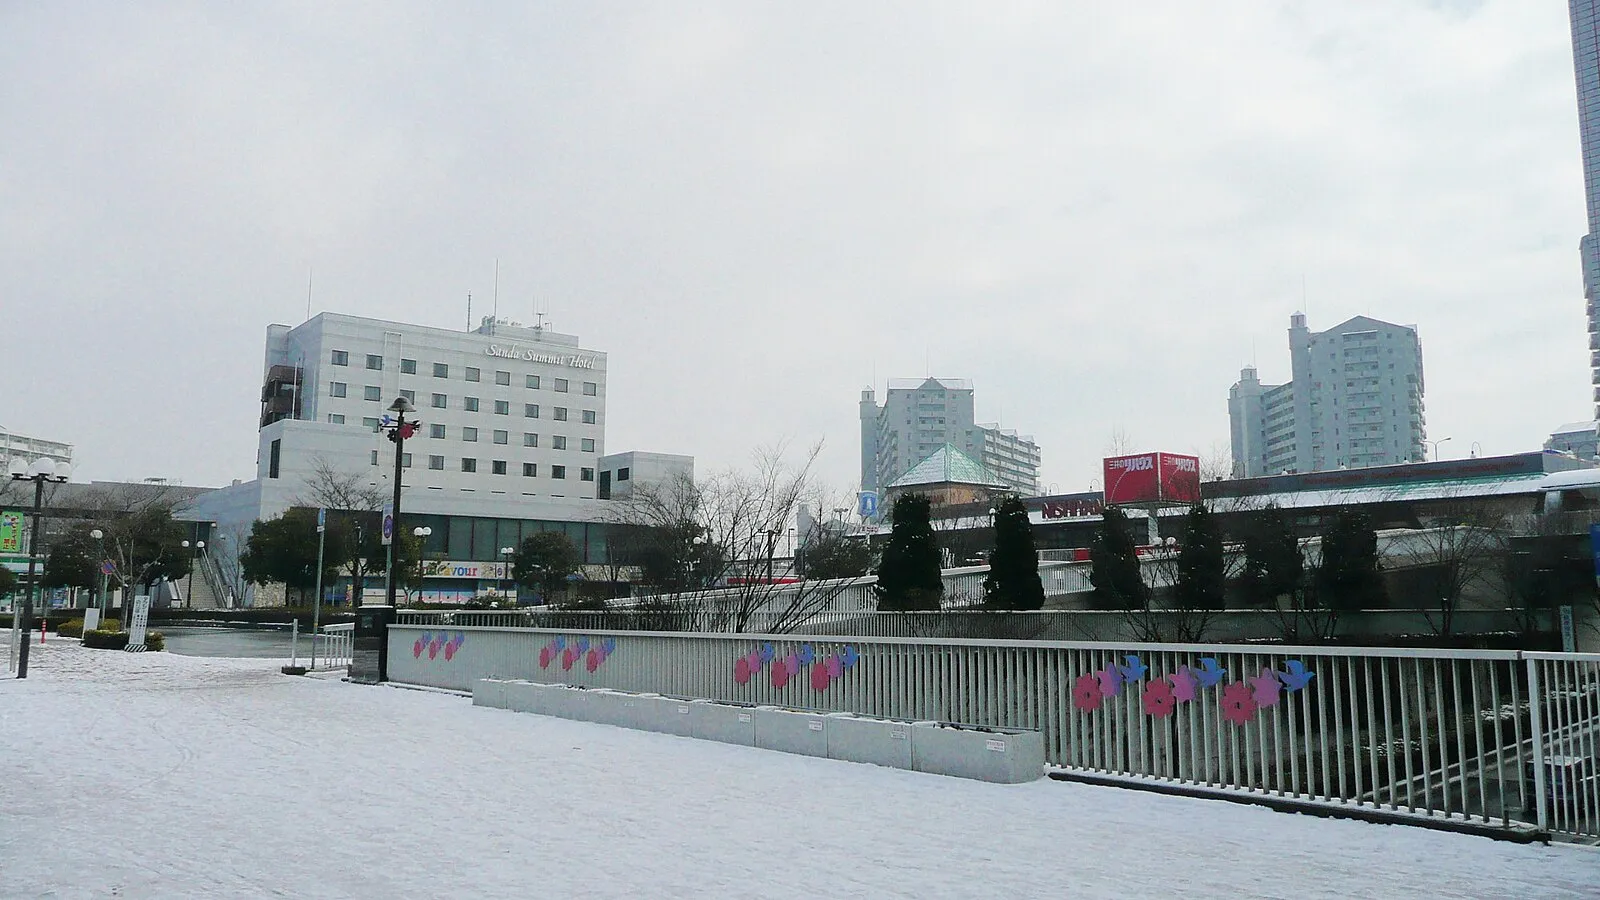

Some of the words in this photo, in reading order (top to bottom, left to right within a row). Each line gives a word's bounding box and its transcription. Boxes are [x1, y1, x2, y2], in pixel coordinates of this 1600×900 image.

[485, 344, 519, 359] Sanda
[522, 350, 564, 365] Summit
[567, 354, 598, 369] Hotel
[1109, 456, 1153, 471] 三井のリハウス
